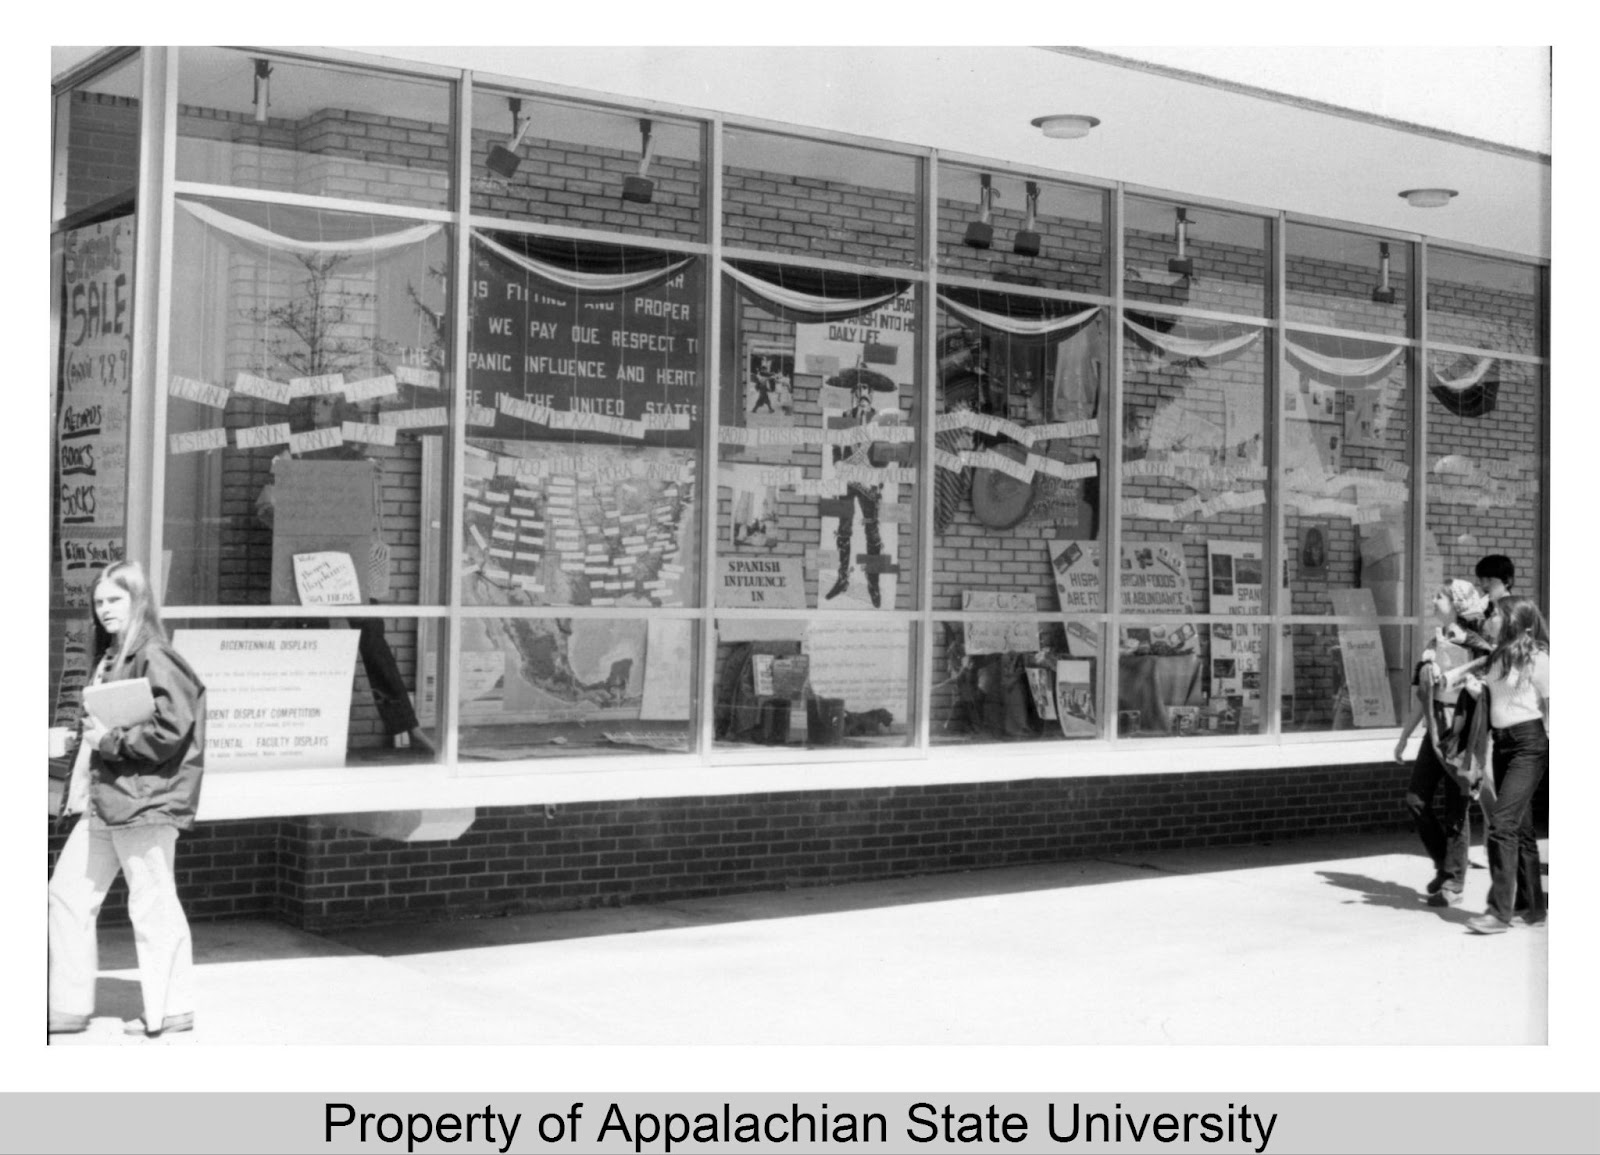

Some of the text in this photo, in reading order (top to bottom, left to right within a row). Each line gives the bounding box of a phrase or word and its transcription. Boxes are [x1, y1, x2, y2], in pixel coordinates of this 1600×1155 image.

[473, 281, 489, 298] IS
[635, 297, 690, 320] PROPER
[72, 274, 126, 346] SALE
[880, 314, 902, 331] INTO
[489, 317, 512, 335] WE
[530, 321, 558, 339] PAY
[571, 325, 600, 344] DUE
[612, 331, 675, 352] RESPECT
[829, 325, 880, 345] DAILY LIFE
[525, 356, 607, 378] INFLUENCE
[617, 365, 645, 382] AND
[526, 393, 554, 410] THE
[570, 397, 625, 416] UNITED
[61, 443, 94, 469] BOOKS
[61, 484, 96, 516] SOCKS
[728, 561, 781, 573] SPANISH
[724, 575, 786, 587] INFLUENCE
[1147, 574, 1176, 588] FOODS
[751, 591, 765, 602] IN
[1067, 592, 1087, 605] ARE
[219, 640, 318, 651] BICENTENNIAL DISPLAYS
[233, 708, 266, 719] DISPLAY
[271, 708, 321, 719] COMPETITION
[256, 736, 290, 748] FACULTY
[294, 736, 329, 747] DISPLAYS
